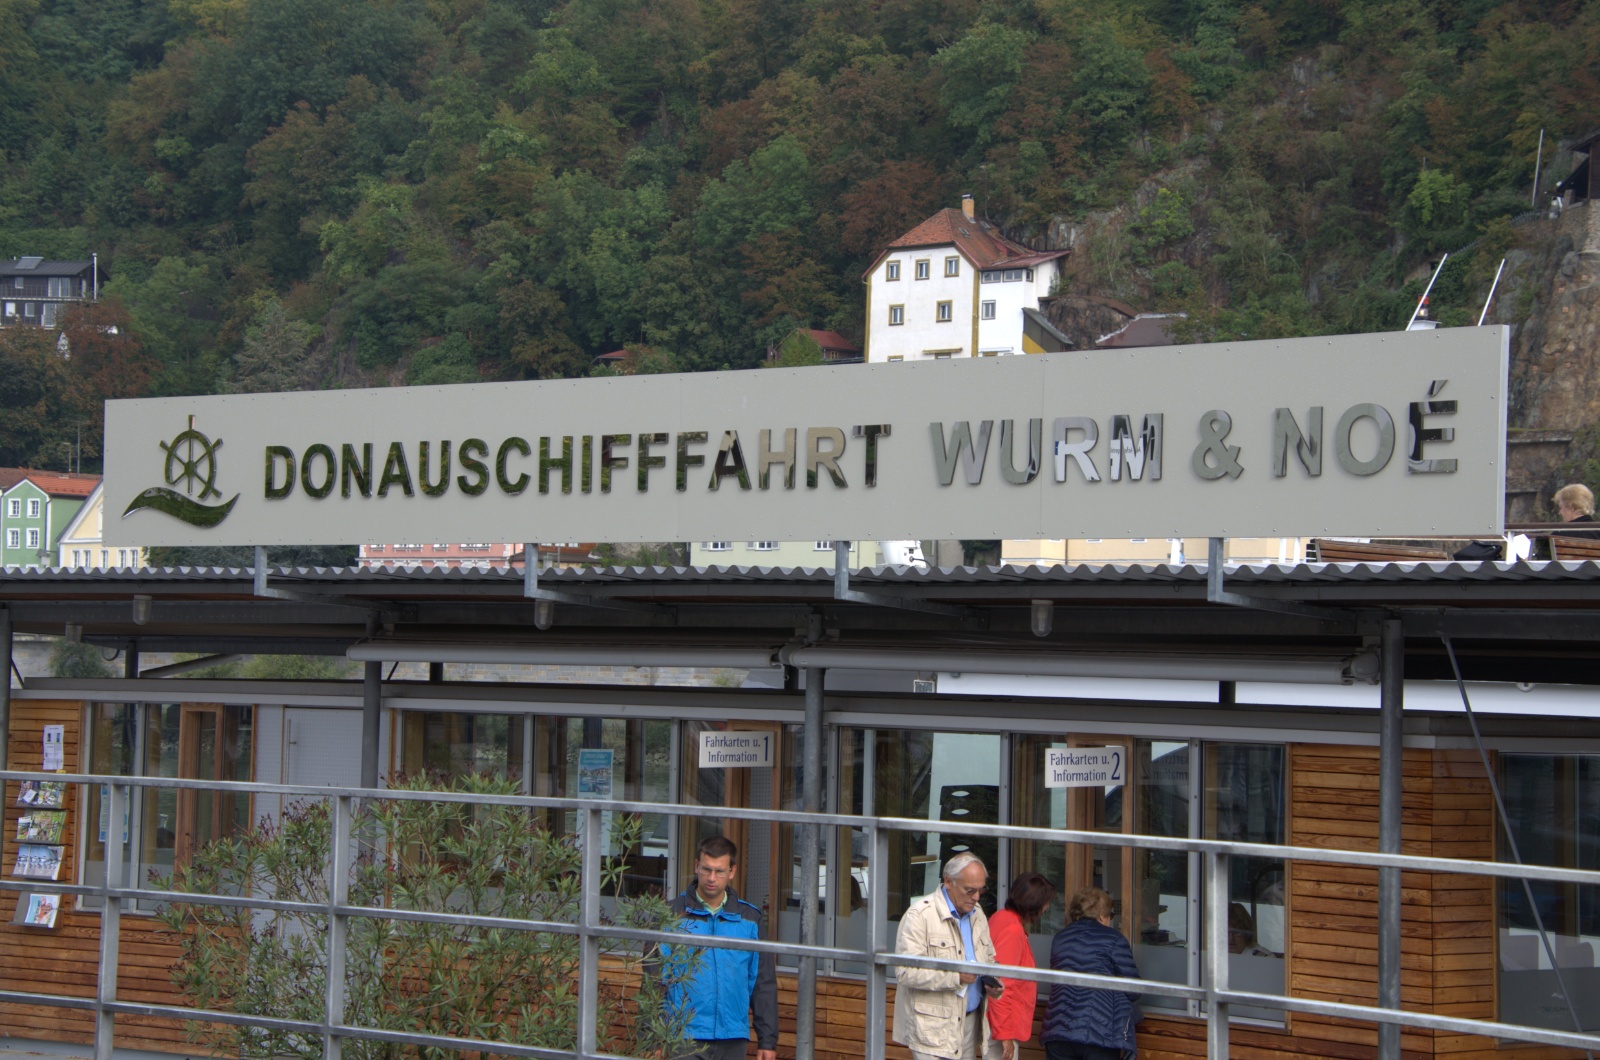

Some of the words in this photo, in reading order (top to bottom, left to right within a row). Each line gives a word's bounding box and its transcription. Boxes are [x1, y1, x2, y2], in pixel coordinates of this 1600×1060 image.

[265, 424, 891, 499] DONAUSCHIFFFAHRT
[930, 413, 1164, 487] WURM
[1192, 409, 1244, 480] &
[1272, 379, 1459, 478] NOÉ
[705, 736, 749, 747] Fahrkarten
[753, 739, 761, 747] u.
[763, 736, 769, 761] 1
[708, 751, 757, 762] Information
[1050, 753, 1098, 766] Fahrkarten
[1101, 755, 1110, 765] u.
[1111, 752, 1121, 780] 2
[1053, 769, 1106, 782] Information
